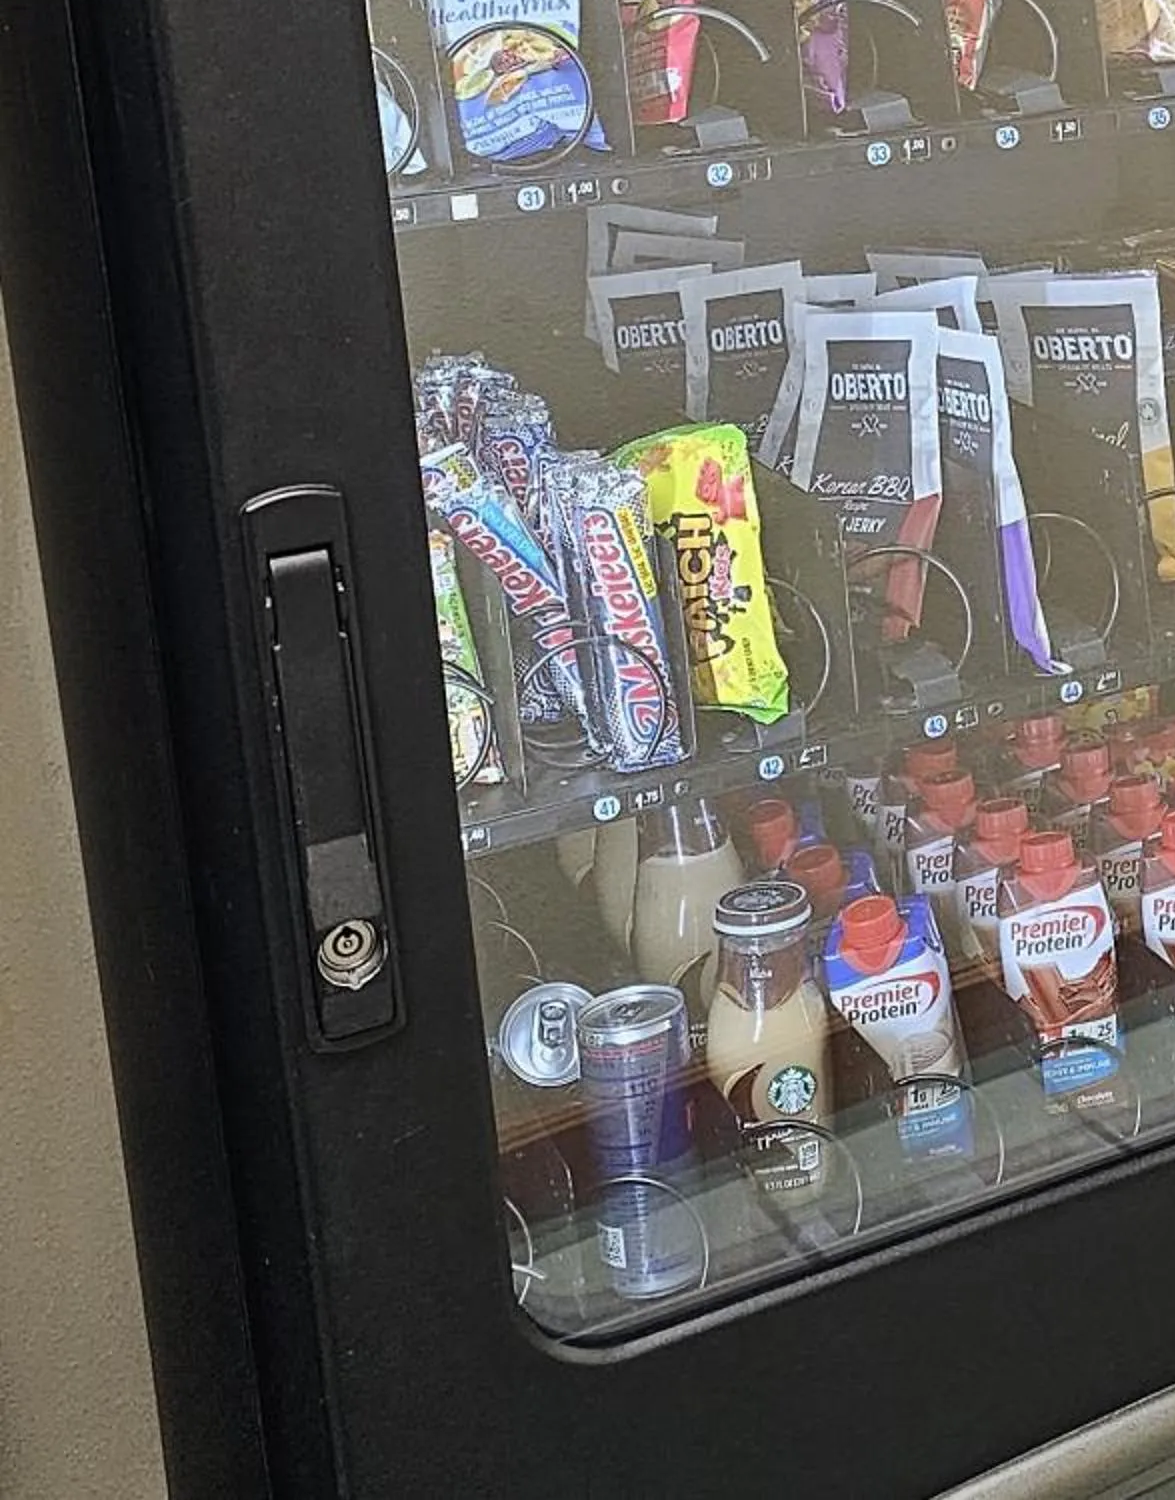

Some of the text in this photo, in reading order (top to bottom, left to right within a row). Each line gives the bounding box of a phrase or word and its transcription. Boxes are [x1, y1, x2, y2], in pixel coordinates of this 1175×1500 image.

[428, 0, 519, 30] Healthy
[1000, 129, 1016, 145] 34
[869, 145, 888, 162] 33
[711, 166, 730, 182] 32
[522, 190, 542, 207] 31
[711, 319, 783, 352] OBERTO
[1034, 335, 1133, 362] OBERTO
[831, 372, 907, 401] OBERTO
[867, 474, 912, 500] BBQ
[845, 518, 887, 535] JERKY
[926, 717, 945, 733] 43
[763, 759, 780, 775] 42
[599, 800, 618, 818] 41
[1011, 912, 1089, 940] Premier
[1015, 934, 1085, 956] Protein
[840, 983, 921, 1014] Premier
[847, 1001, 919, 1025] Protein
